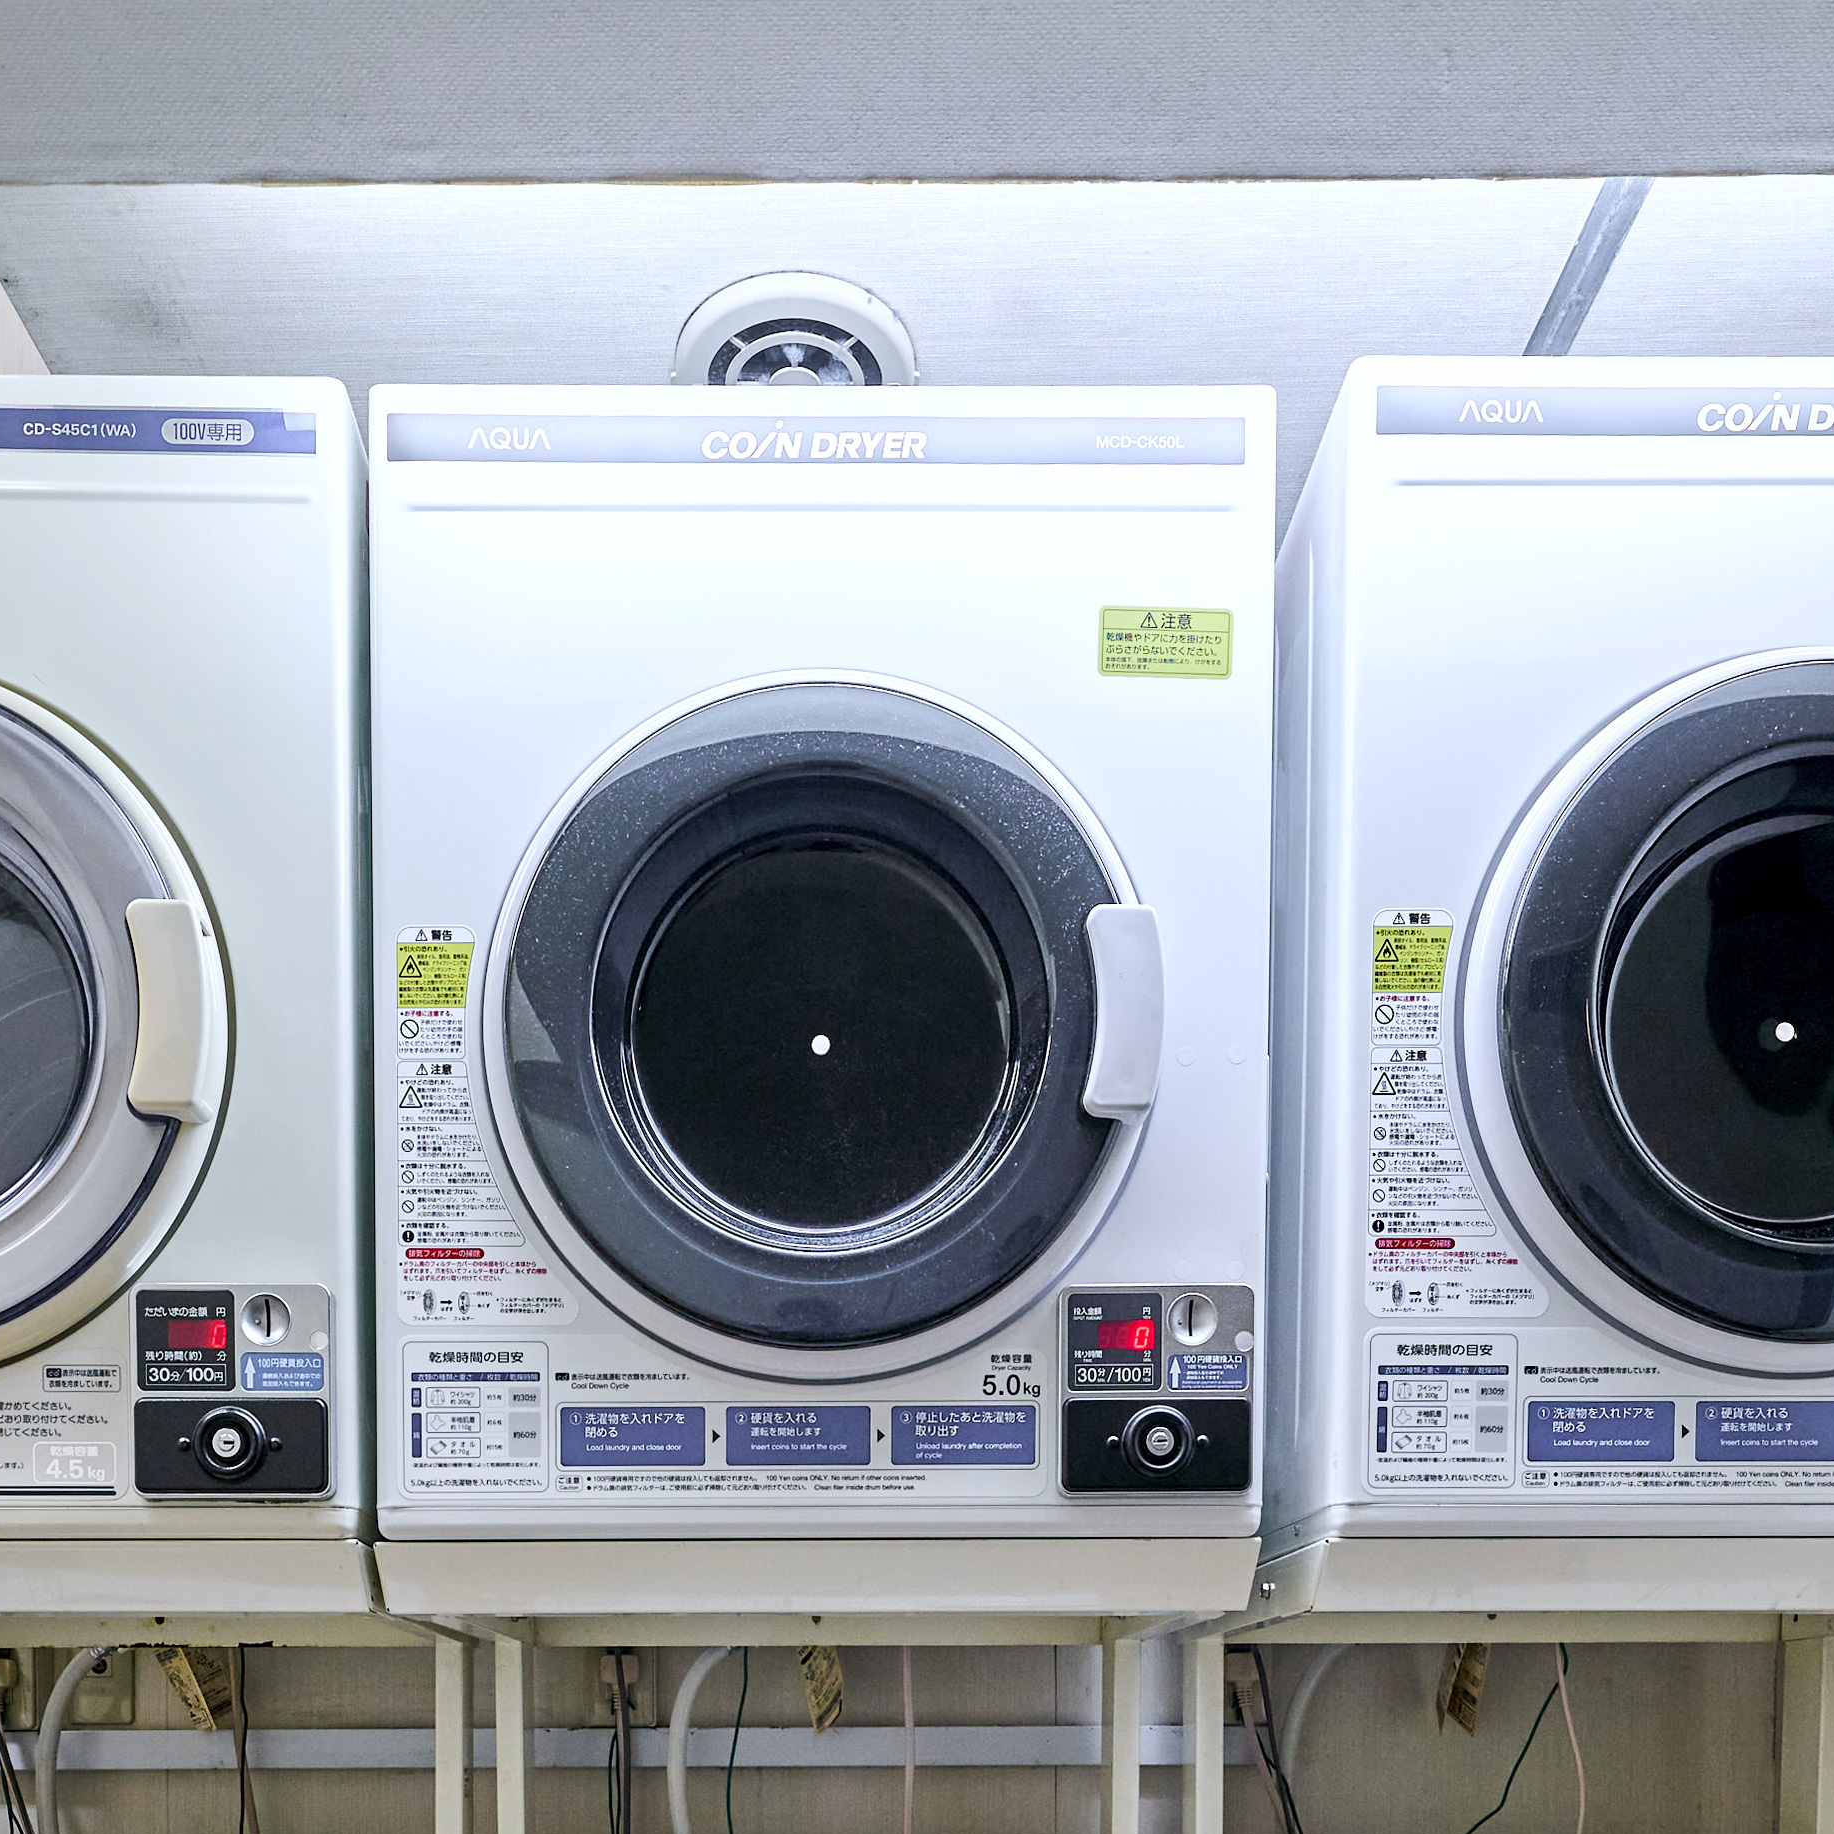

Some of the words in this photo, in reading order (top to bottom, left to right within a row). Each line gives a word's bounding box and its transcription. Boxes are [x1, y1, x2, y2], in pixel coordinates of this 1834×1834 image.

[1458, 399, 1543, 422] AQUA
[1697, 391, 1800, 431] COIN
[23, 422, 136, 438] CD-S45C1(WA)
[173, 422, 241, 441] 100V専用
[468, 427, 551, 450] AQUA
[702, 419, 802, 459] COIN
[810, 432, 927, 458] DRYER
[1096, 436, 1184, 448] MCD-CK50L
[1161, 613, 1192, 629] 注意
[1107, 633, 1222, 644] 乾燥機やドアに力を掛けたり
[1106, 645, 1217, 656] ぶらさがらないでください。
[1409, 914, 1431, 924] 警告
[431, 930, 452, 940] 警告
[1405, 1050, 1427, 1061] 注意
[431, 1064, 452, 1074] 注意
[145, 1307, 207, 1317] ただいまの金額
[216, 1307, 226, 1317] 円
[1073, 1307, 1102, 1315] 投入金額
[1143, 1307, 1151, 1315] 円
[212, 1323, 226, 1347] 0
[1134, 1327, 1149, 1348] 0
[1074, 1351, 1102, 1359] 残り時間
[1397, 1345, 1493, 1356] 乾燥時間の目安
[217, 1352, 227, 1361] 分
[429, 1352, 524, 1363] 乾燥時間の目安
[991, 1355, 1032, 1363] 乾燥容量
[258, 1358, 321, 1368] 100円硬貨投入口
[148, 1367, 224, 1382] 30分/100円
[982, 1375, 1020, 1395] 5.0
[1023, 1383, 1040, 1397] kg
[513, 1393, 536, 1401] 約30分
[585, 1413, 685, 1424] 洗濯物を入れドアを
[751, 1412, 817, 1424] 硬貨を入れる
[916, 1412, 1025, 1423] 停止したあと洗濯物を
[1553, 1407, 1654, 1419] 洗濯物を入れドアを
[1721, 1407, 1788, 1419] 硬貨を入れる
[585, 1427, 618, 1438] 閉める
[916, 1426, 958, 1437] 取り出す
[1480, 1425, 1503, 1433] 約60分
[1553, 1421, 1586, 1433] 閉める
[1721, 1423, 1792, 1432] 運転を開始します
[513, 1431, 536, 1439] 約60分
[605, 1444, 630, 1452] laundry
[942, 1442, 967, 1450] laundry
[985, 1442, 1022, 1450] completion
[1573, 1439, 1598, 1447] laundry
[45, 1459, 83, 1479] 4.5
[88, 1465, 105, 1481] kg
